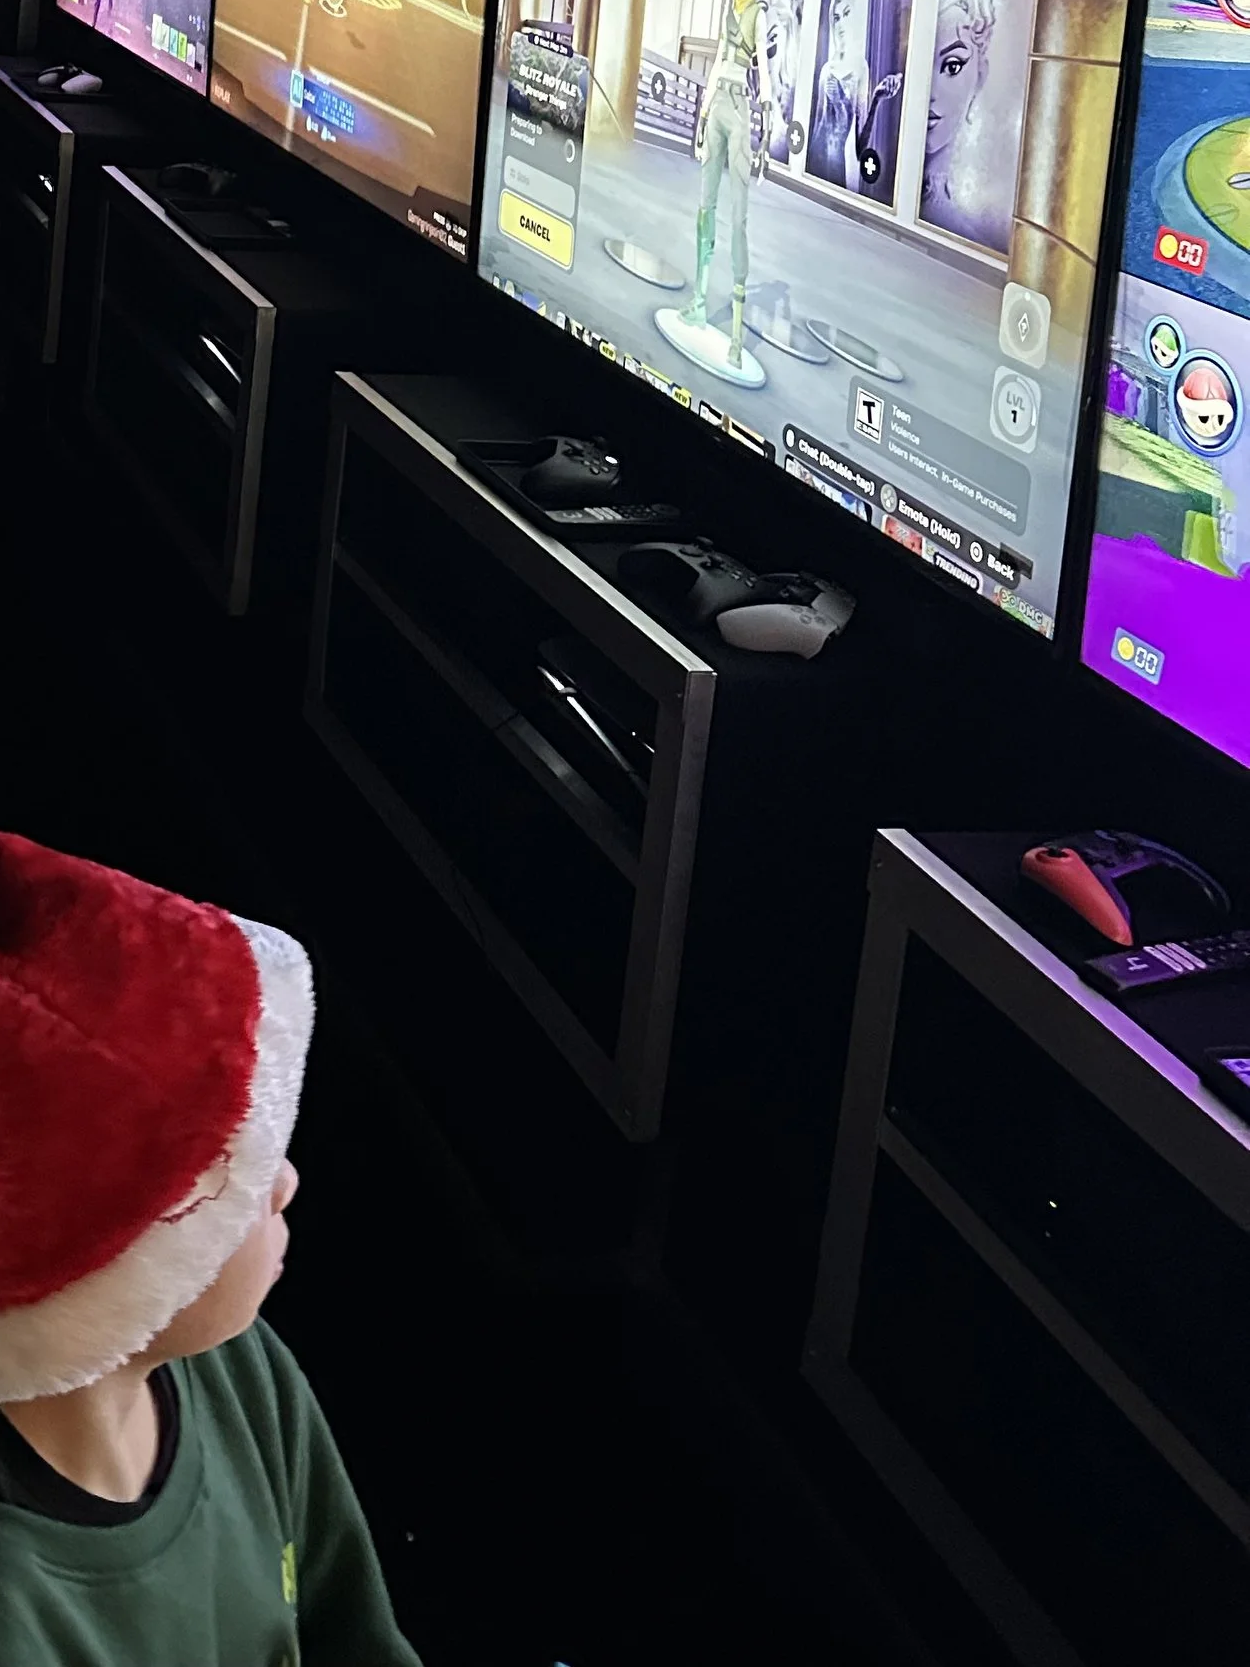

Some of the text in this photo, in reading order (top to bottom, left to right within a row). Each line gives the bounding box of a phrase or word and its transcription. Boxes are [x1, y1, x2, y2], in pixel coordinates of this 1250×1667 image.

[519, 64, 578, 98] BLITZ ROYALE
[511, 112, 543, 135] Preparing to
[510, 127, 536, 147] Download
[519, 215, 551, 242] CANCEL
[1177, 240, 1203, 267] 00
[602, 345, 614, 359] NEW
[674, 387, 688, 405] NEW
[1006, 390, 1025, 411] LVL
[863, 400, 876, 424] T
[892, 404, 911, 424] Teen
[1011, 409, 1017, 423] 1
[890, 420, 920, 445] Violence
[888, 441, 909, 461] Users
[941, 471, 975, 497] In-Game
[975, 491, 1017, 523] Purchases
[798, 439, 1015, 581] Chat (Double-tap) Emote (Hold) Back
[935, 554, 978, 590] TRENDING
[1018, 600, 1043, 624] DMG
[1134, 646, 1158, 675] 00
